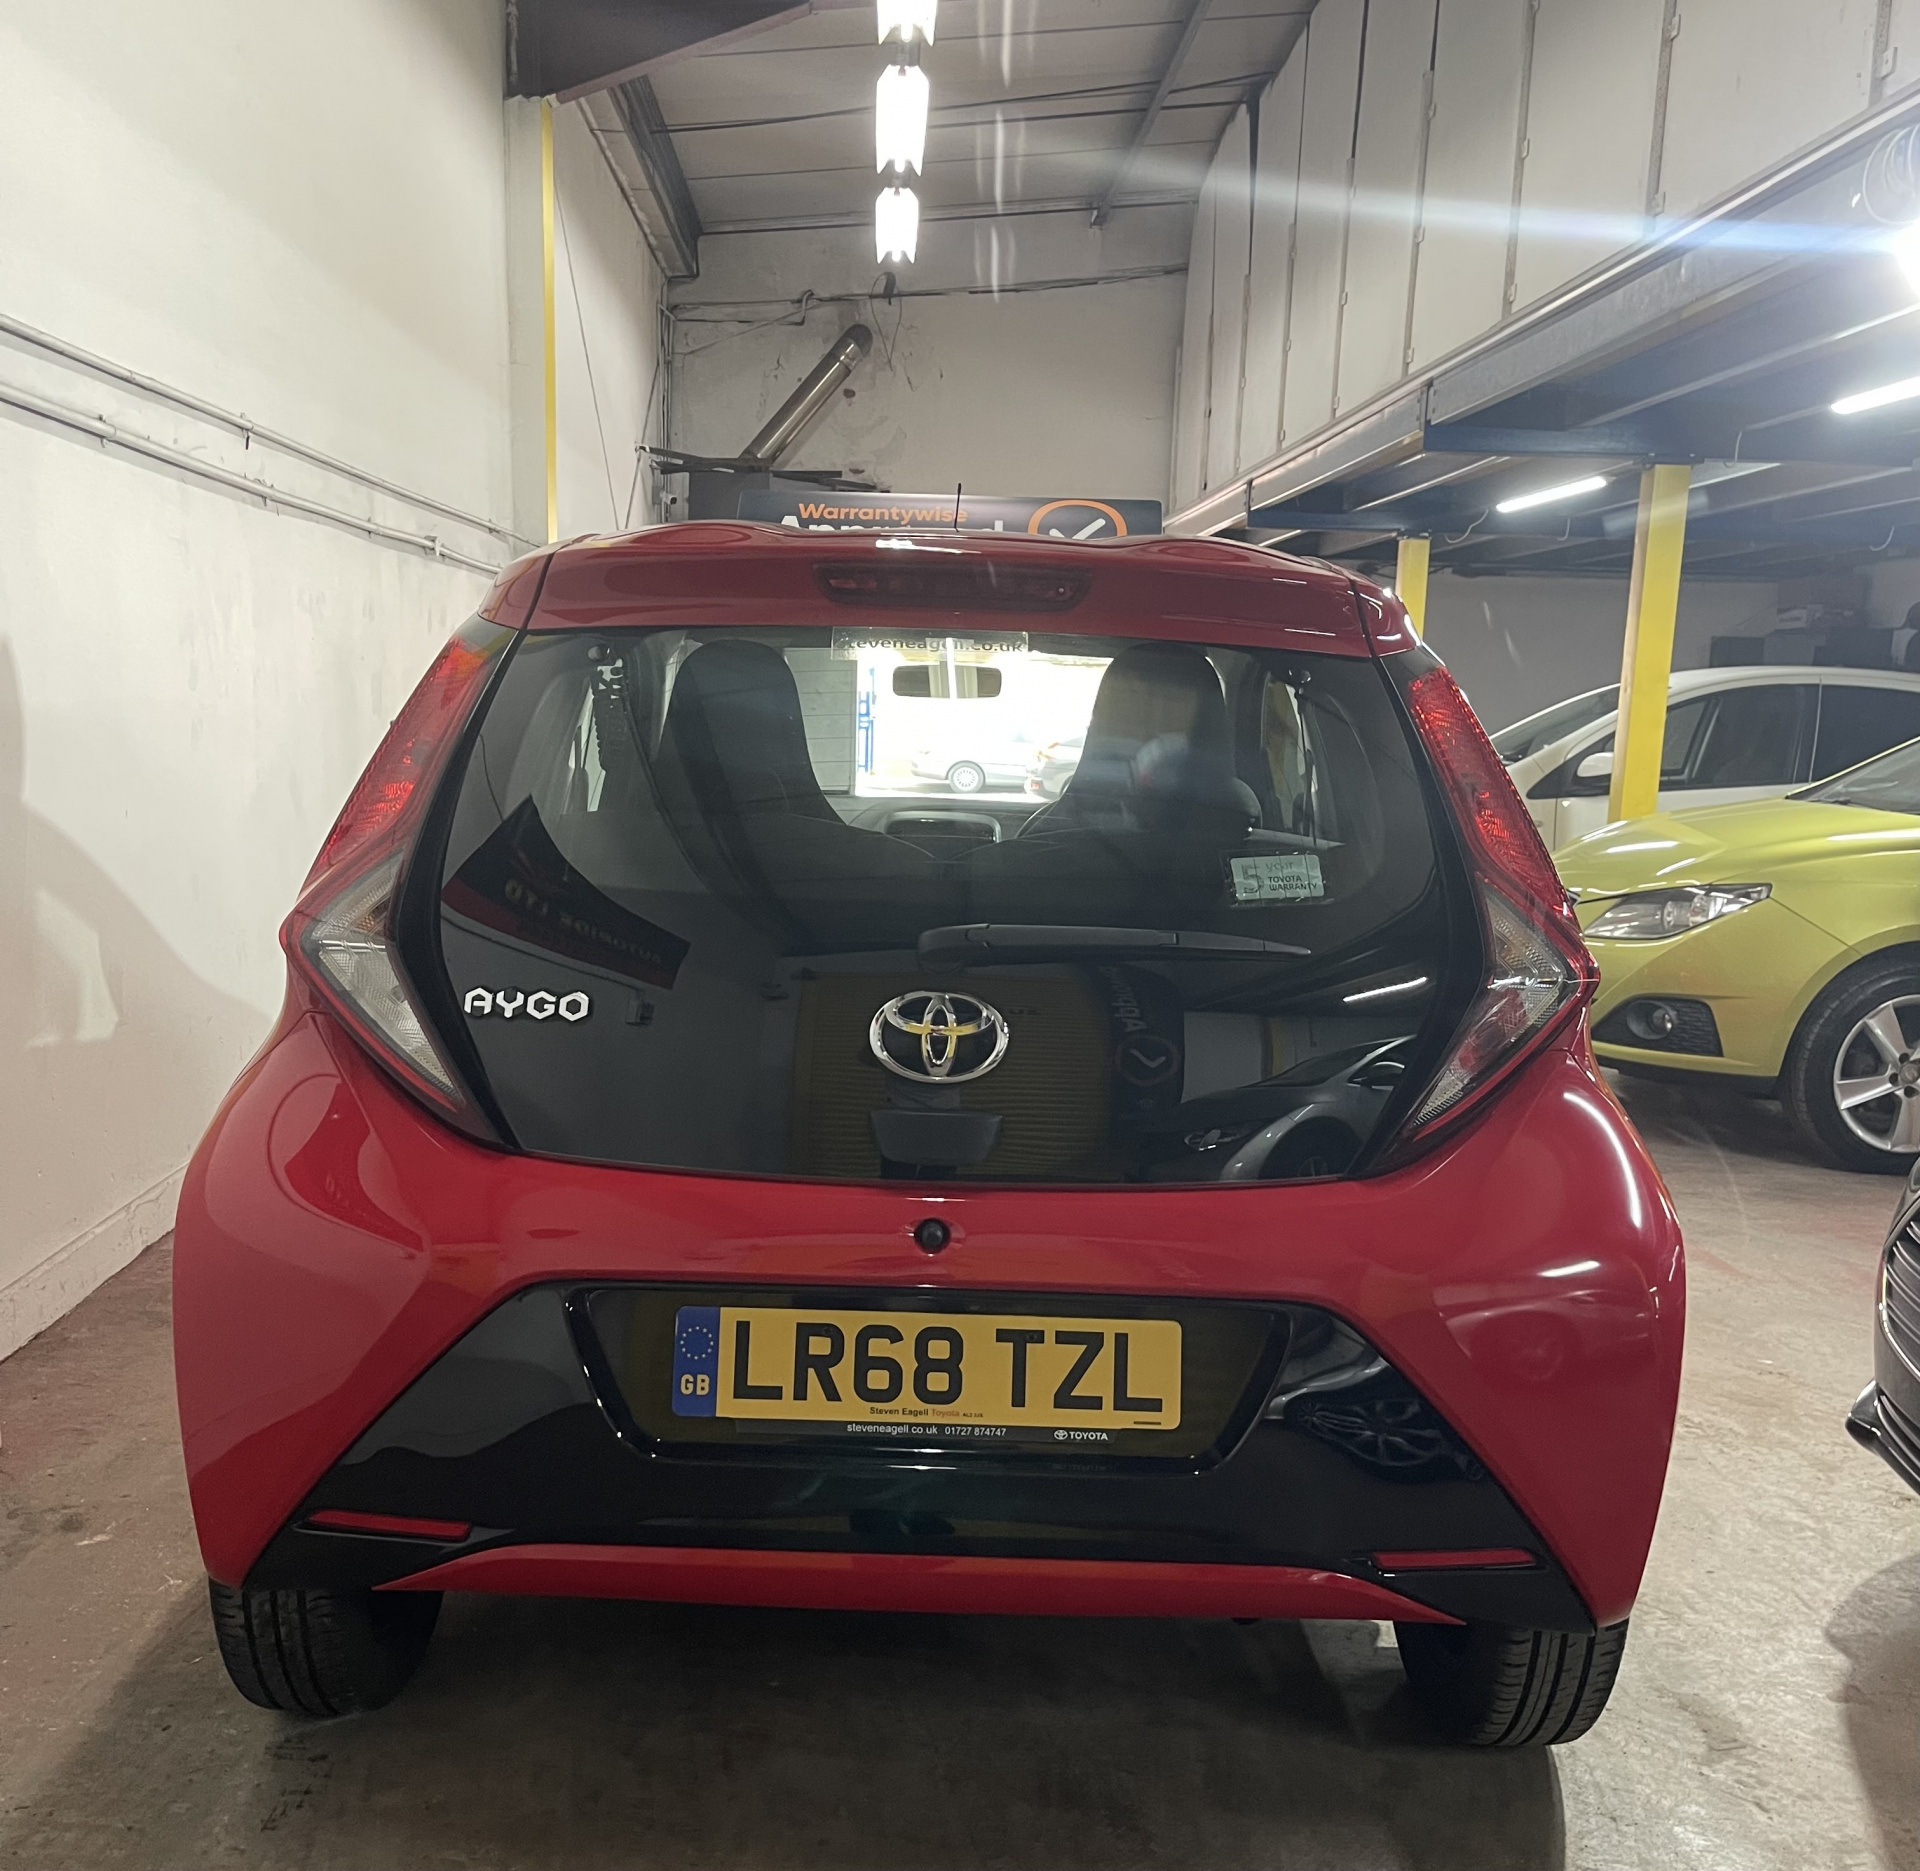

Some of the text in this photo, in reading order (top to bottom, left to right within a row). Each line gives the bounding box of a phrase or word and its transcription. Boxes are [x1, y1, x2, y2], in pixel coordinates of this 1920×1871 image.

[799, 503, 968, 525] Warrantywise
[838, 637, 1022, 654] teveneagll.co.uk
[1241, 864, 1264, 893] 5
[1267, 876, 1302, 884] TOYOTA
[1269, 883, 1317, 892] WARRANTY
[464, 987, 589, 1022] AYGO
[733, 1320, 1162, 1412] LR68 TZL
[680, 1374, 710, 1395] GB
[870, 1407, 899, 1415] Steven
[902, 1408, 928, 1417] Eagell
[932, 1409, 959, 1417] Toyota
[945, 1426, 972, 1436] 01727
[974, 1427, 1006, 1437] 874747
[1069, 1431, 1109, 1441] TOYOTA
